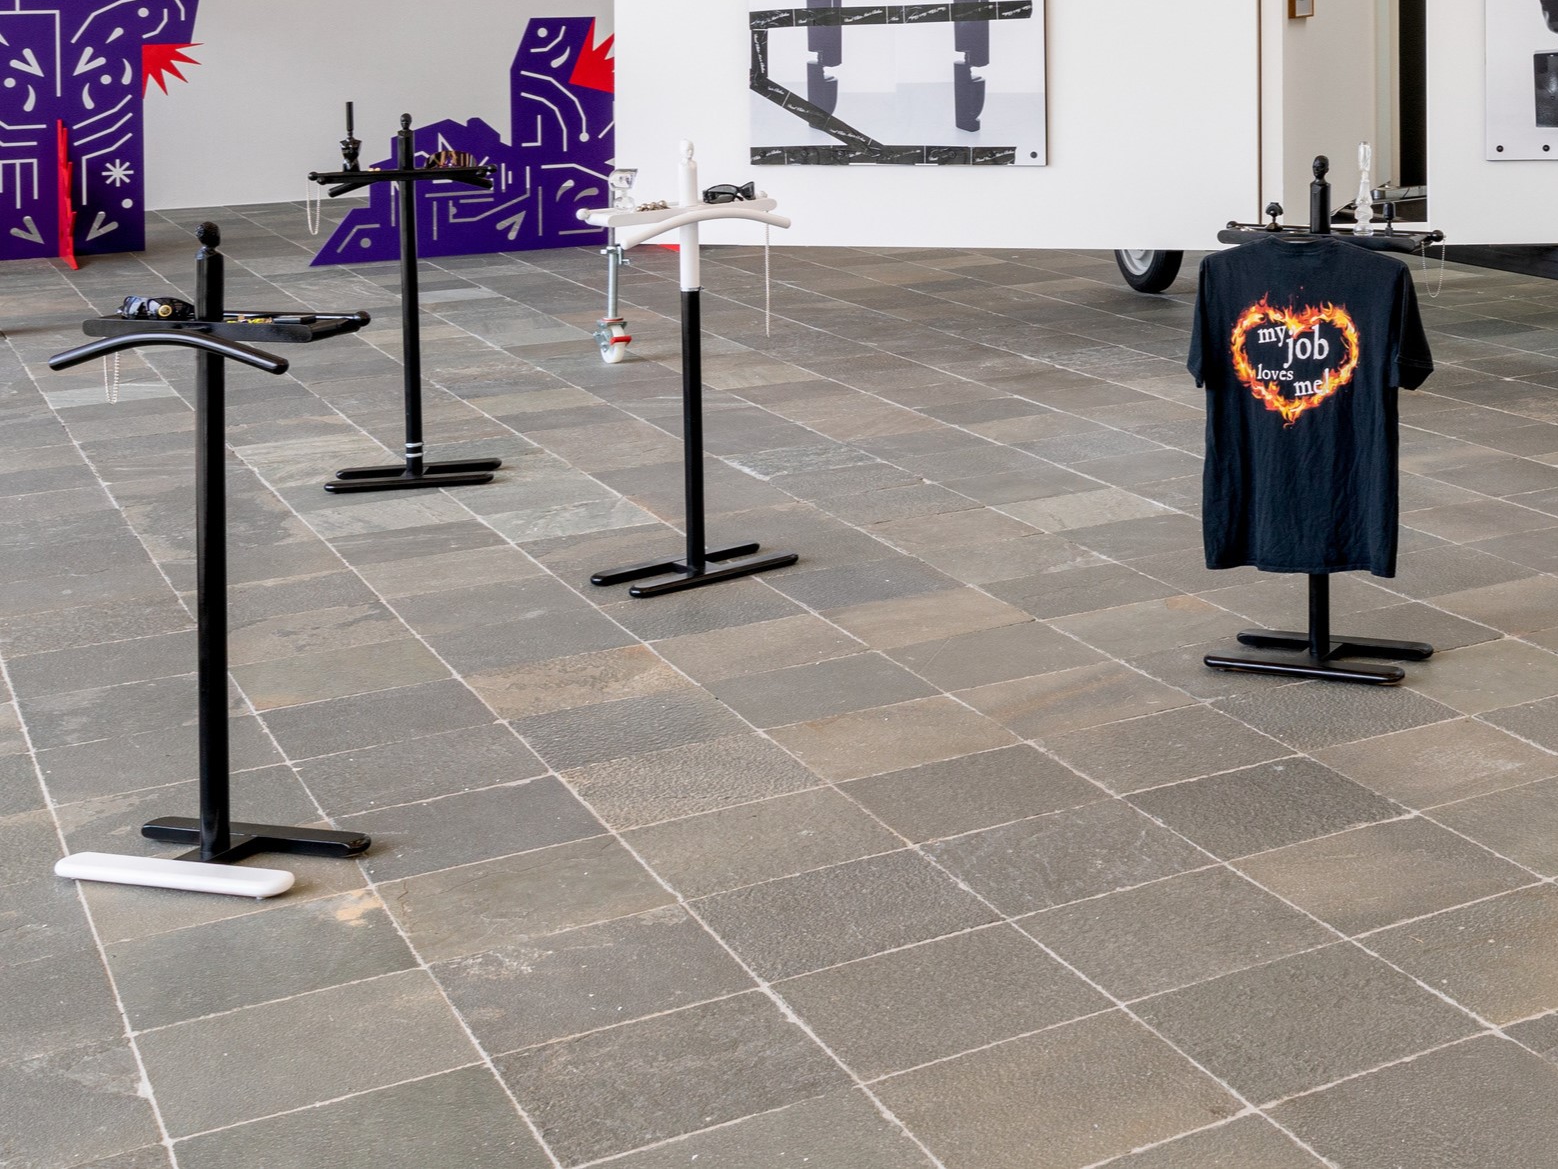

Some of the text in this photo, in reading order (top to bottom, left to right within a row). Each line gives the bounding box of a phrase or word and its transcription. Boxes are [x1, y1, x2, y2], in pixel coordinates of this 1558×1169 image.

[1257, 324, 1330, 368] my job
[1256, 363, 1330, 397] loves me!
